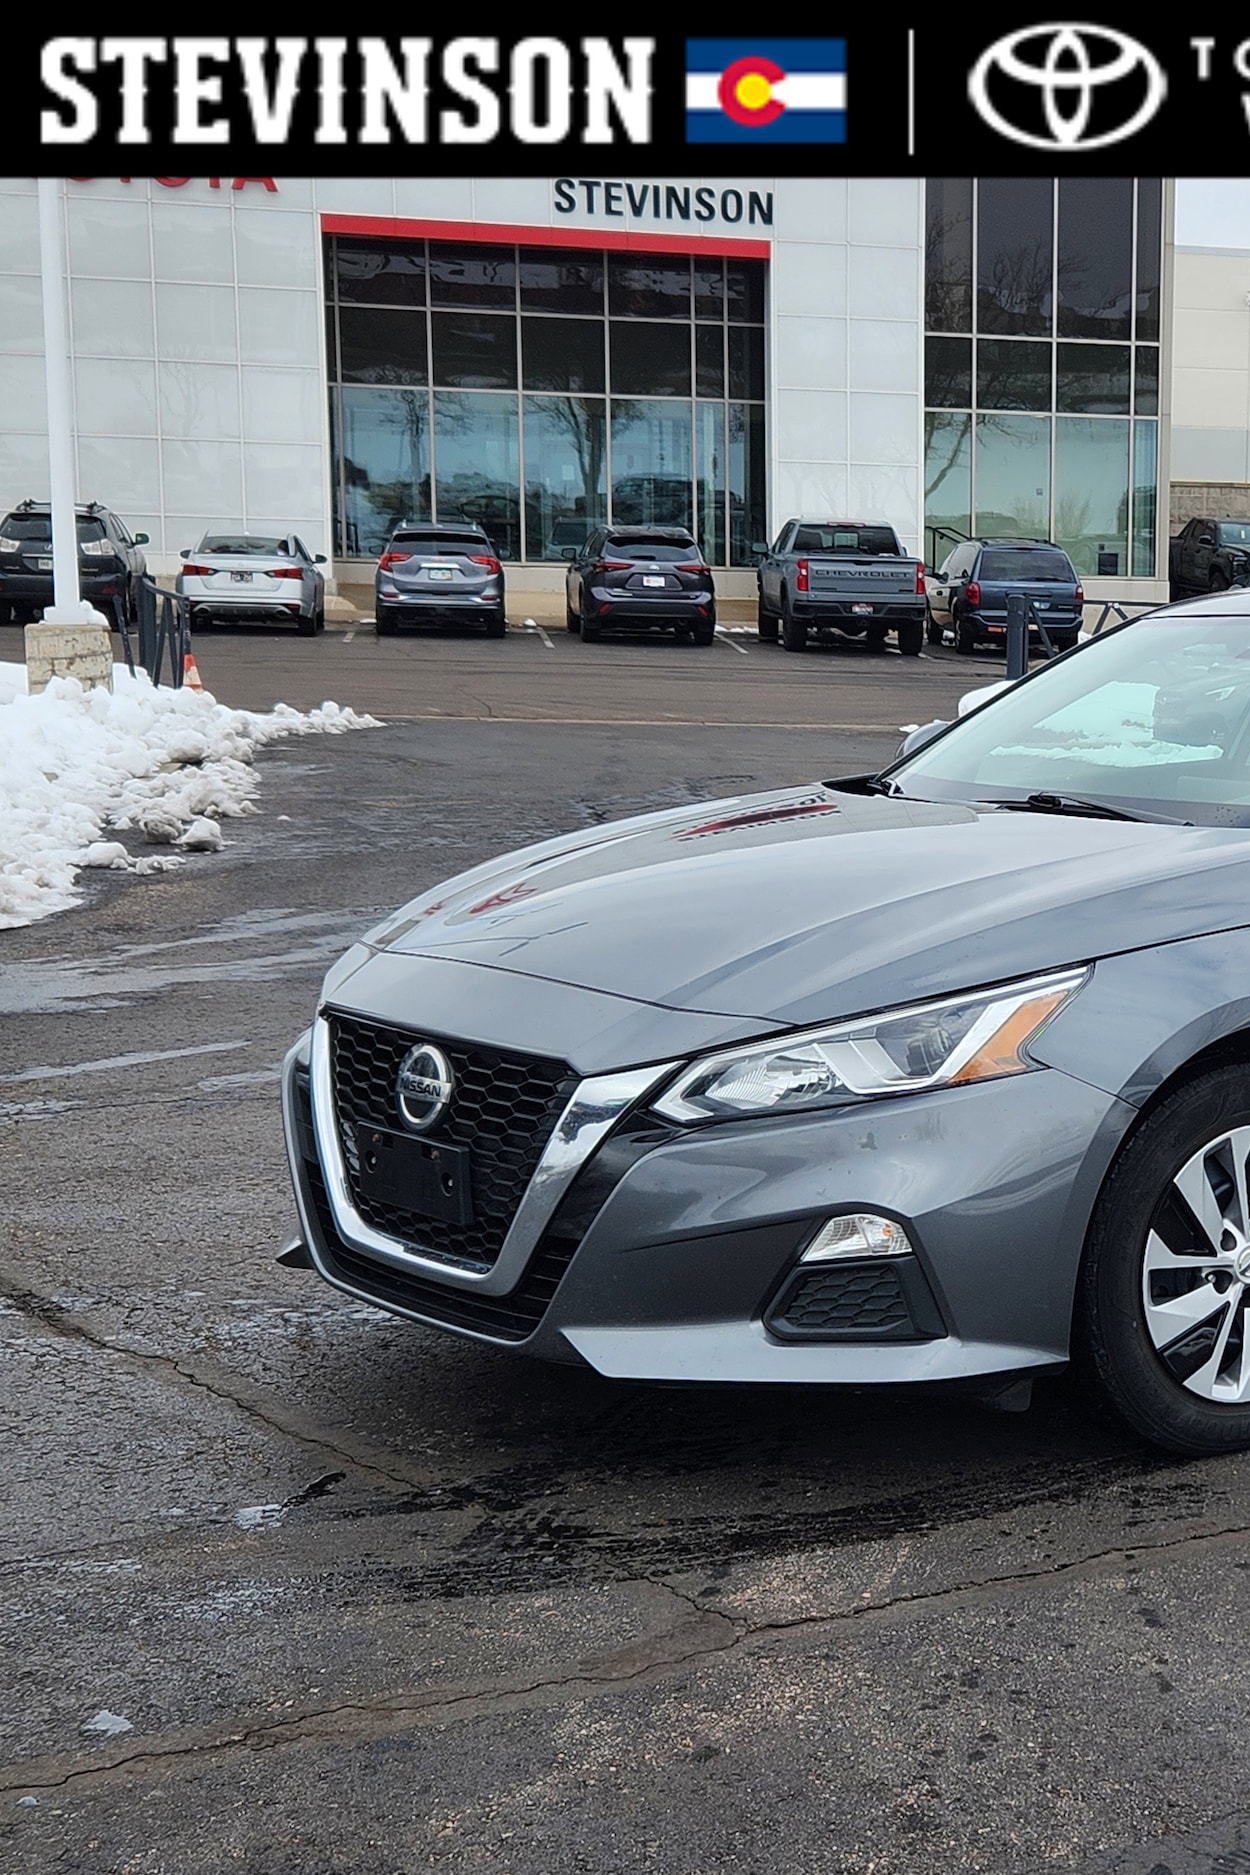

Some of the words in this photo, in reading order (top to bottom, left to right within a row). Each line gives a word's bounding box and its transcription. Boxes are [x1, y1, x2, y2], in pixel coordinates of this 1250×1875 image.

[554, 179, 774, 226] STEVINSON
[815, 569, 910, 579] CHEVROLET
[401, 1077, 442, 1097] NISSAN
